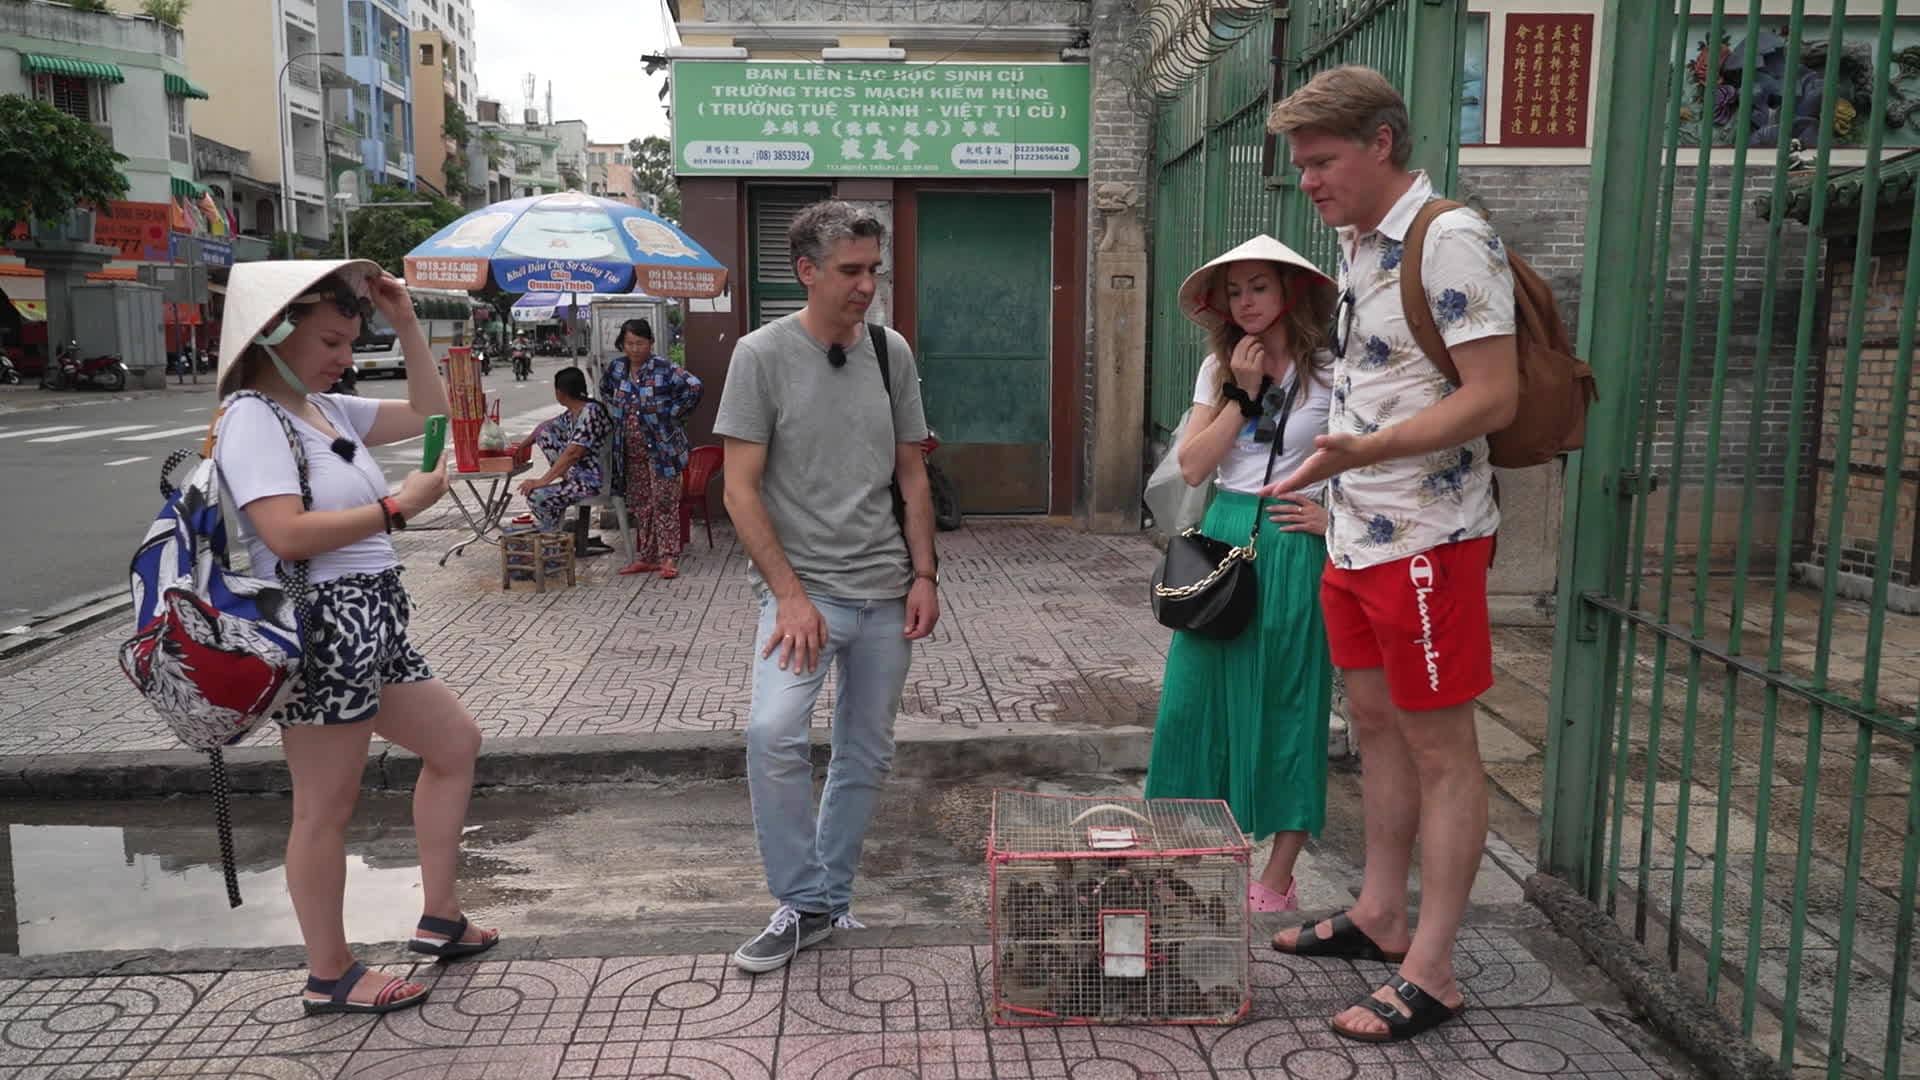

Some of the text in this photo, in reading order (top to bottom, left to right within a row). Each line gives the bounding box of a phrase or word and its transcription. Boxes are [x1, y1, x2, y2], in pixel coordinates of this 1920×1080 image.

[745, 68, 787, 81] BAN
[893, 69, 936, 84] HỌC
[944, 69, 993, 82] SINH
[711, 82, 796, 98] TRƯỜNG
[799, 86, 857, 99] THCS
[864, 86, 924, 102] MẠCH
[797, 101, 838, 119] TUỆ
[848, 100, 920, 117] THÀNH
[939, 101, 988, 120] VIỆT
[773, 150, 810, 161] 38539324
[1409, 554, 1440, 692] Champion
